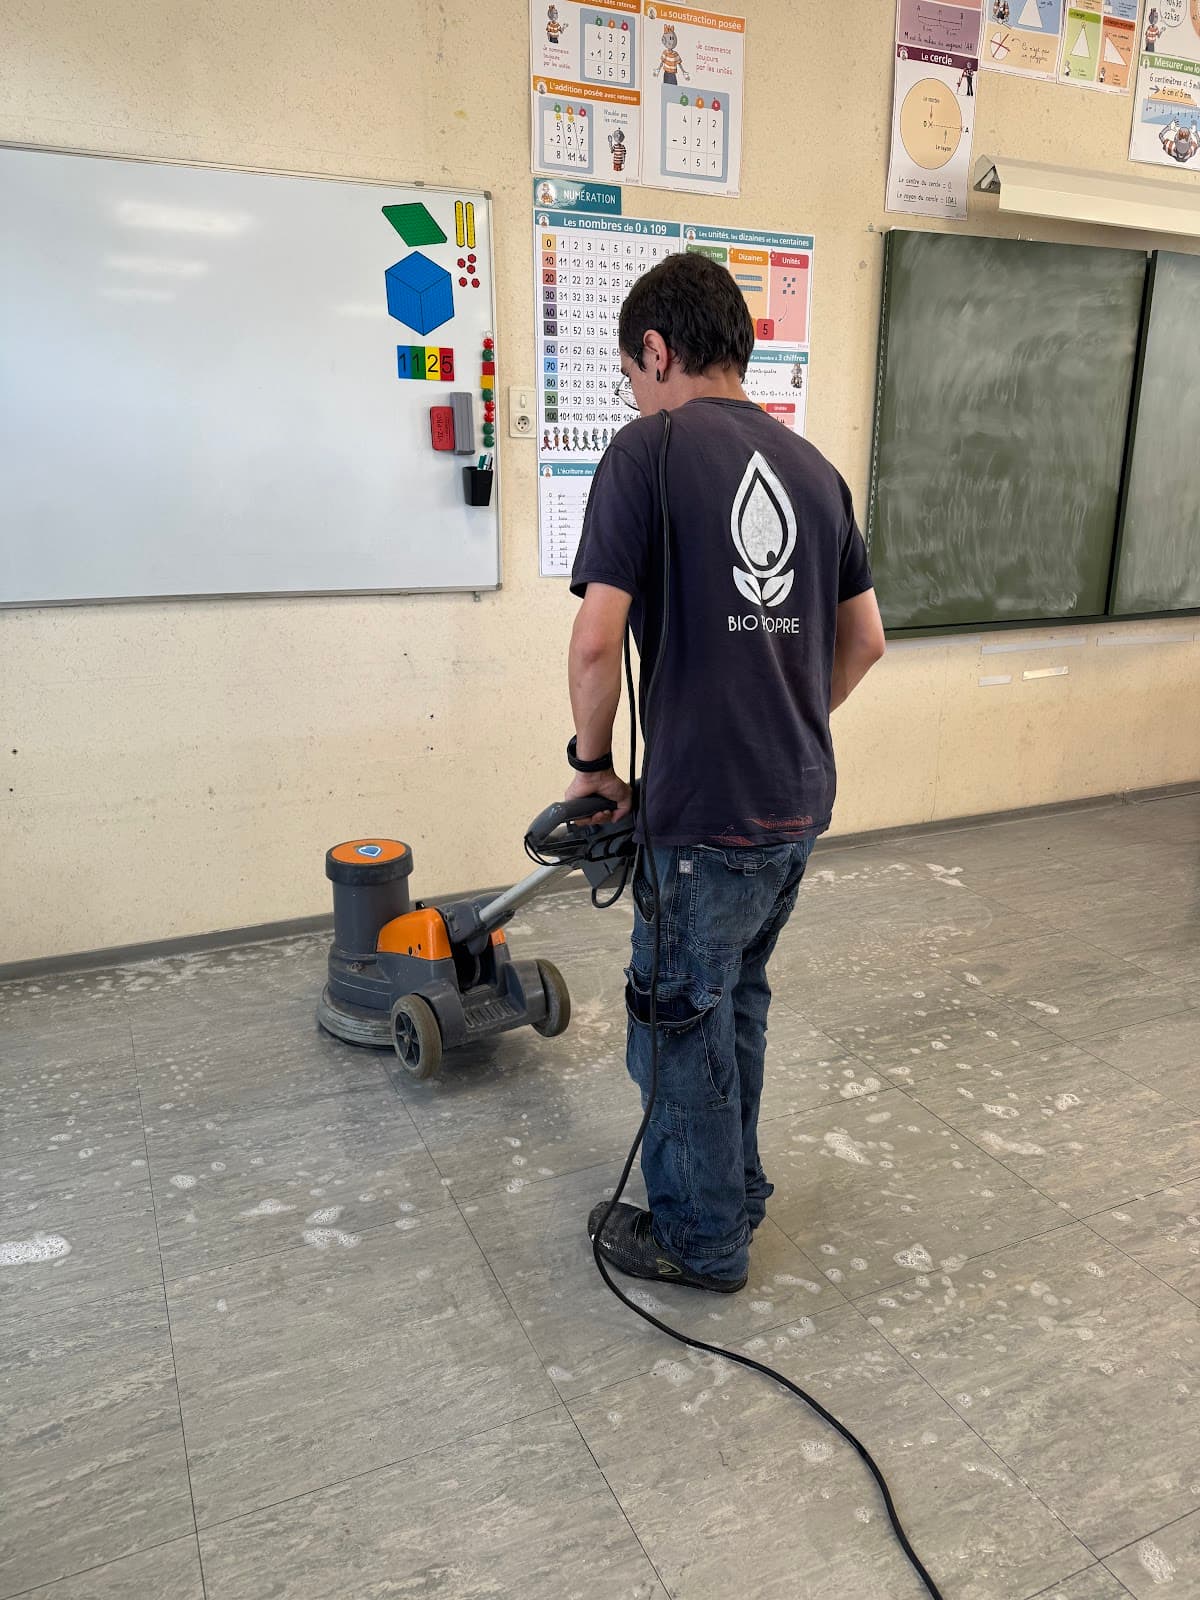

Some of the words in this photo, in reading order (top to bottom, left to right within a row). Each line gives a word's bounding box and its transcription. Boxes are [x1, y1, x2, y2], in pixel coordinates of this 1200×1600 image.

[660, 9, 667, 17] La
[668, 10, 716, 26] soustraction
[719, 20, 742, 30] posée
[608, 33, 613, 42] 3
[621, 35, 626, 45] 2
[608, 51, 613, 60] 2
[921, 53, 929, 61] Le
[930, 54, 953, 65] cercle
[1154, 57, 1183, 70] Mesurer
[597, 65, 602, 75] 5
[608, 67, 613, 77] 5
[1150, 72, 1154, 82] 6
[549, 82, 582, 94] L'addition
[583, 87, 603, 98] posée
[1162, 86, 1166, 95] 6
[1180, 89, 1184, 98] 5
[682, 115, 687, 123] 4
[712, 119, 717, 128] 2
[556, 122, 560, 130] 5
[580, 126, 584, 134] 7
[556, 135, 561, 143] 2
[567, 137, 572, 145] 2
[682, 136, 687, 144] 3
[696, 138, 701, 147] 2
[712, 140, 716, 148] 1
[556, 150, 561, 159] 8
[696, 159, 700, 167] 5
[712, 161, 716, 169] 1
[563, 188, 616, 205] NUMÉRATION
[563, 217, 577, 227] Les
[578, 217, 622, 231] nombres
[624, 224, 634, 232] de
[635, 223, 642, 233] 0
[643, 225, 648, 234] à
[650, 224, 667, 235] 109
[546, 239, 552, 248] 0
[738, 233, 765, 243] dizaines
[779, 238, 809, 247] centaines
[738, 253, 763, 262] Dizaines
[782, 256, 801, 265] Unités
[545, 257, 554, 265] 10
[559, 258, 567, 266] 11
[586, 260, 594, 268] 13
[599, 261, 607, 269] 14
[612, 262, 620, 270] 15
[625, 263, 633, 271] 16
[545, 274, 554, 283] 20
[572, 276, 581, 285] 22
[585, 276, 594, 285] 23
[599, 278, 607, 286] 24
[612, 278, 620, 287] 25
[545, 291, 555, 300] 30
[572, 293, 581, 301] 32
[586, 293, 594, 302] 33
[599, 295, 607, 303] 34
[612, 295, 620, 304] 35
[546, 308, 555, 317] 40
[559, 309, 567, 317] 41
[573, 310, 581, 319] 42
[586, 310, 594, 319] 43
[599, 311, 607, 319] 44
[546, 325, 555, 334] 50
[560, 326, 568, 334] 51
[573, 327, 581, 335] 52
[587, 327, 595, 335] 53
[600, 328, 608, 336] 54
[763, 323, 768, 335] 5
[546, 345, 555, 354] 60
[559, 345, 568, 354] 61
[783, 354, 806, 362] chiffres
[547, 362, 555, 371] 70
[574, 363, 582, 372] 72
[586, 363, 594, 371] 73
[612, 364, 620, 373] 75
[546, 378, 556, 387] 80
[586, 381, 594, 389] 83
[599, 381, 607, 389] 84
[547, 396, 556, 404] 90
[560, 396, 569, 404] 91
[573, 397, 582, 405] 92
[586, 396, 594, 405] 93
[611, 397, 620, 405] 95
[560, 413, 570, 421] 101
[573, 413, 583, 421] 102
[585, 413, 596, 421] 103
[611, 413, 621, 422] 105
